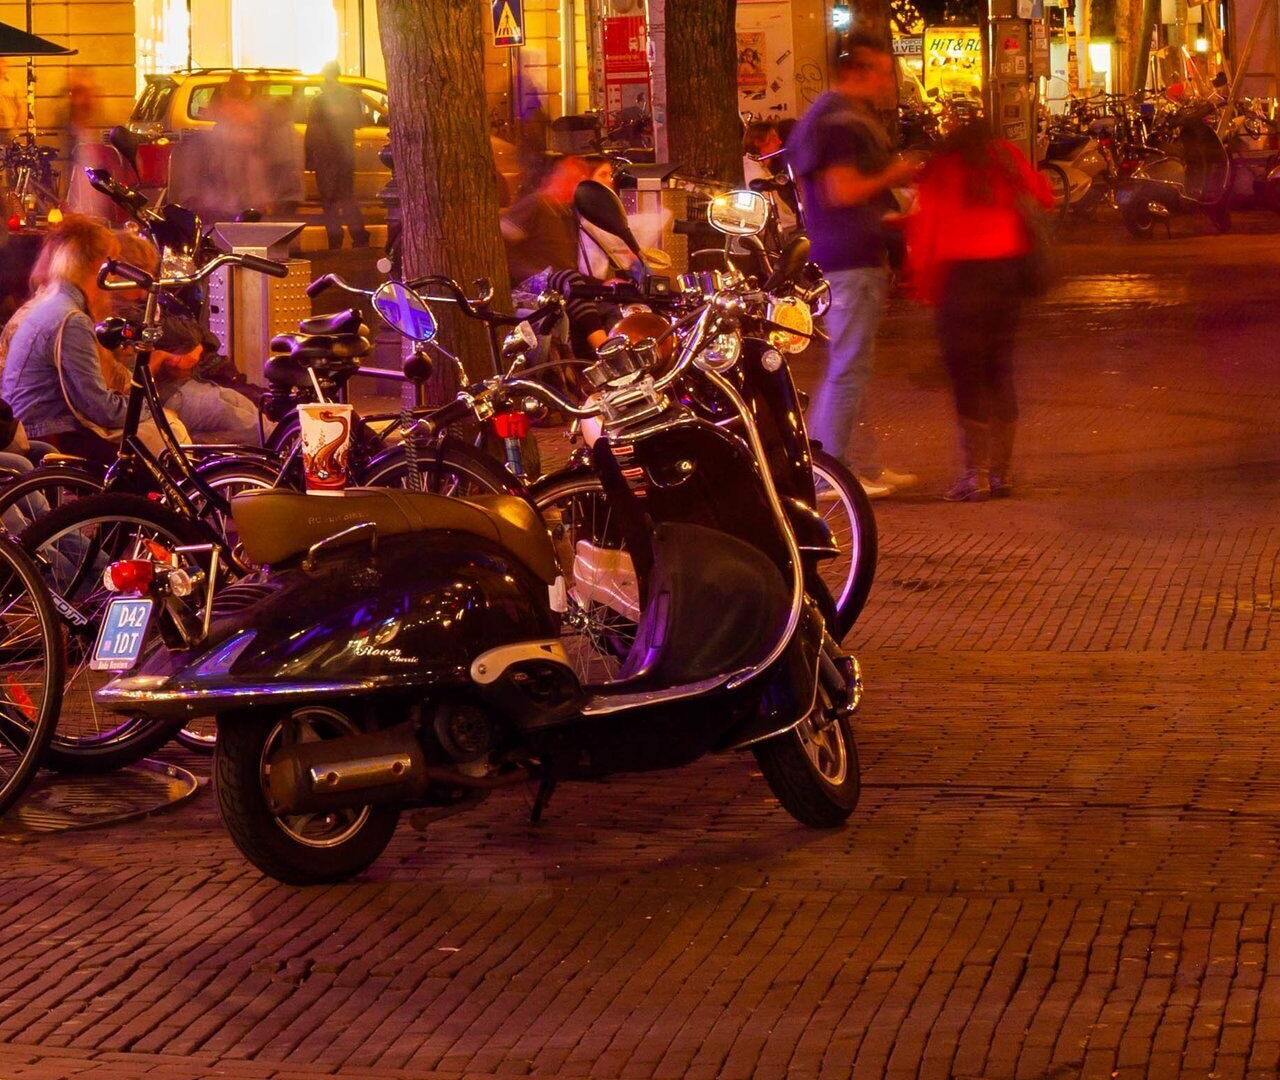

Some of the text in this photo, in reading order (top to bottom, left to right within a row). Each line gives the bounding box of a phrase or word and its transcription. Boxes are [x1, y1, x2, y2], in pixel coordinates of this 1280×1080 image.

[118, 606, 146, 627] D42
[112, 632, 139, 654] 1DT
[356, 645, 402, 657] Rover
